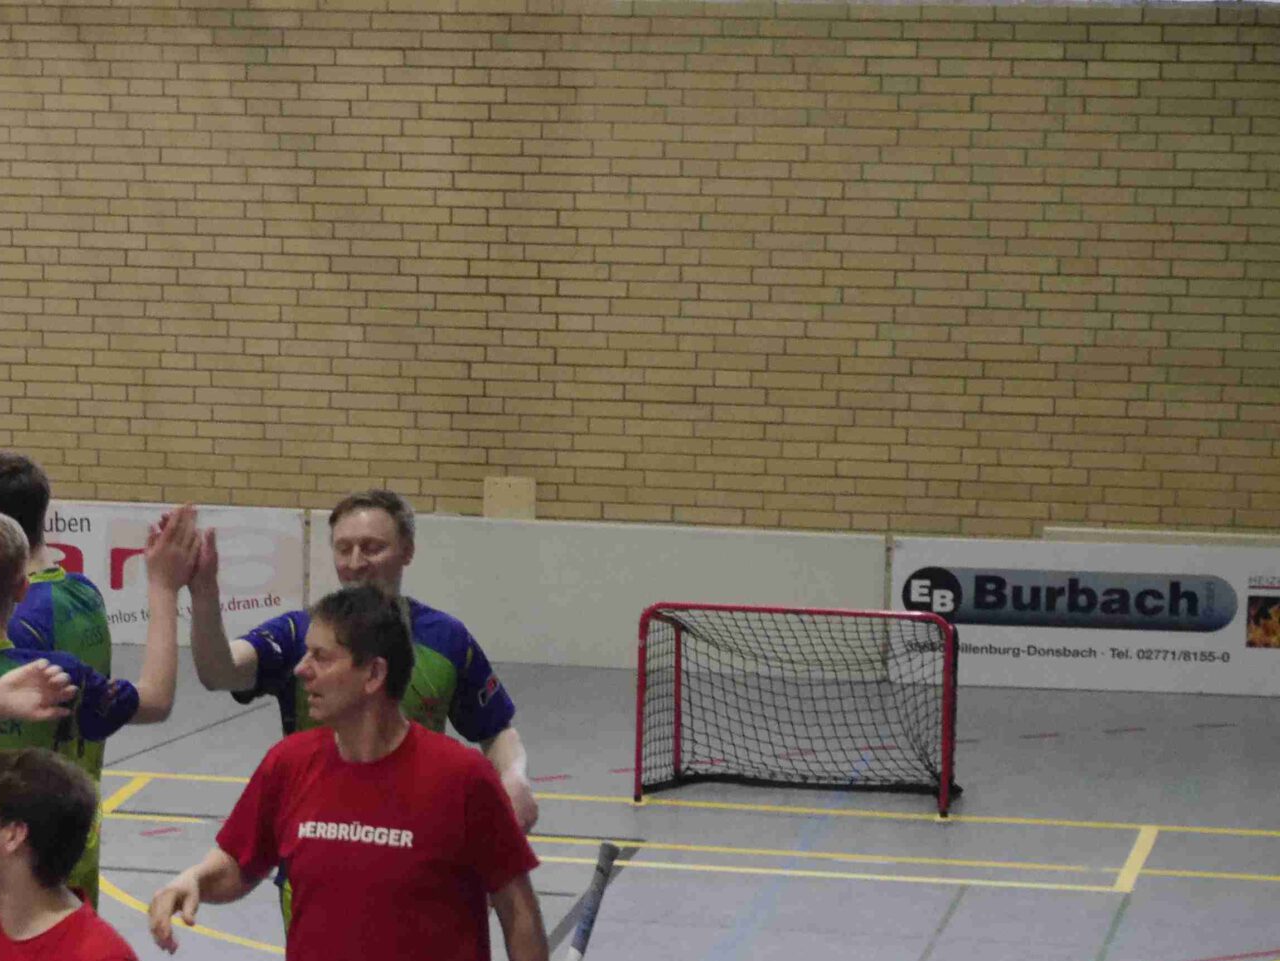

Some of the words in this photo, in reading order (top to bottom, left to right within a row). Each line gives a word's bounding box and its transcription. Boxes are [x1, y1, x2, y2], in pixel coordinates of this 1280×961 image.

[973, 573, 1200, 618] Burbach
[959, 642, 1098, 660] illenburg-Donsbach
[1109, 646, 1134, 660] Tel.
[1136, 648, 1231, 664] 02771/8155-0
